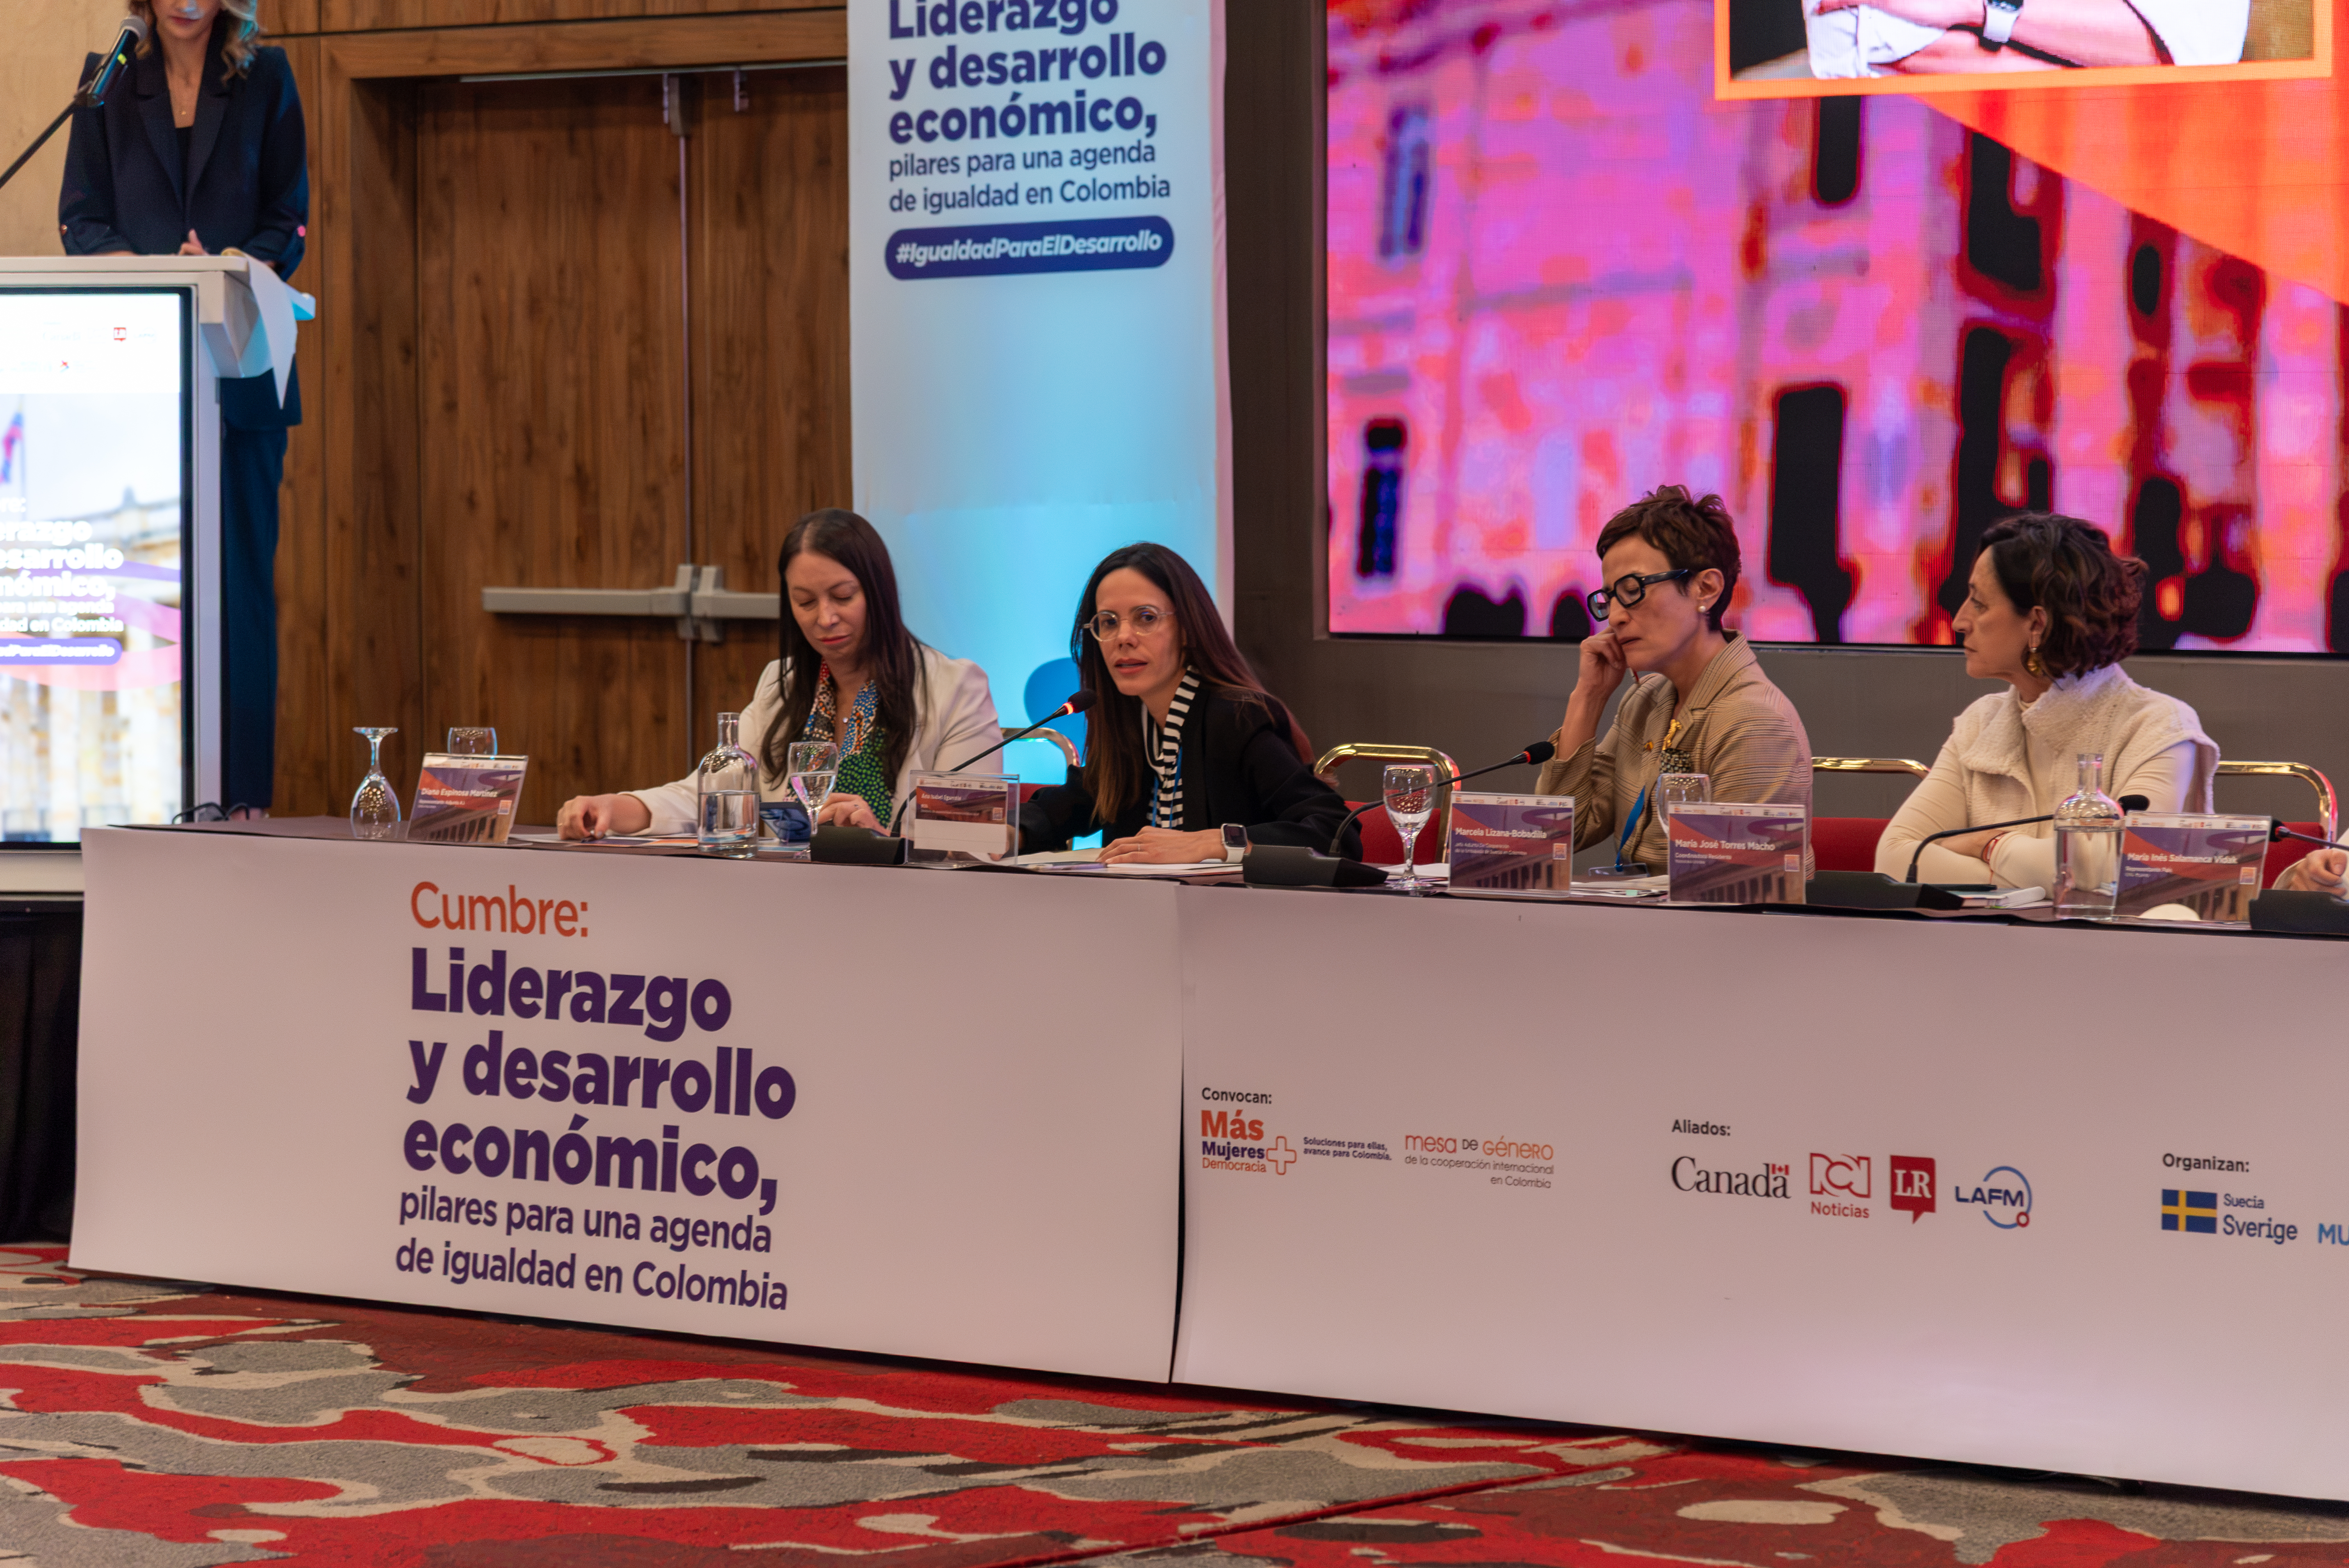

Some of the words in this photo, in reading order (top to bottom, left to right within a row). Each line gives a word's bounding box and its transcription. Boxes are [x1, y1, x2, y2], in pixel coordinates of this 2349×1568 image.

[889, 0, 1118, 39] Liderazgo
[889, 59, 916, 101] y
[929, 32, 1166, 89] desarrollo
[889, 89, 1157, 144] económico,
[889, 153, 960, 181] pilares
[967, 148, 1015, 177] para
[1023, 147, 1062, 169] una
[1070, 140, 1156, 170] agenda
[889, 188, 917, 212] de
[923, 182, 1018, 214] igualdad
[1026, 184, 1053, 205] en
[1060, 175, 1170, 203] Colombia
[895, 230, 1162, 267] #IgualdadParaElDesarrollo
[0, 521, 93, 546] razgo
[51, 617, 124, 632] Colombia
[1455, 827, 1484, 836] Marcela
[1699, 840, 1719, 849] José
[1720, 841, 1746, 850] Torres
[1747, 842, 1776, 851] Macho
[410, 881, 588, 937] Cumbre:
[411, 947, 732, 1042] Liderazgo
[406, 1040, 448, 1104] y
[463, 1030, 796, 1119] desarrollo
[1202, 1087, 1272, 1104] Convocan:
[1201, 1109, 1264, 1141] Más
[1672, 1119, 1731, 1137] Aliados:
[1202, 1141, 1265, 1161] Mujeres
[1303, 1137, 1346, 1147] Soluciones
[1303, 1147, 1330, 1156] avance
[1405, 1135, 1457, 1153] mesa
[404, 1113, 778, 1215] económico,
[1202, 1157, 1267, 1172] Democracia
[1404, 1155, 1417, 1164] de
[1419, 1155, 1428, 1165] la
[1430, 1158, 1491, 1169] cooperación
[1492, 1161, 1554, 1174] internacional
[2162, 1153, 2250, 1172] Organizan:
[1490, 1176, 1503, 1185] en
[1504, 1176, 1551, 1188] Colombia
[1672, 1156, 1792, 1199] Canada
[1893, 1169, 1932, 1199] LR
[1810, 1201, 1870, 1219] Noticias
[2223, 1193, 2265, 1209] Suecia
[399, 1185, 498, 1227] pilares
[506, 1199, 574, 1235] para
[584, 1208, 641, 1240] una
[650, 1215, 772, 1253] agenda
[2222, 1214, 2298, 1245] Sverige
[395, 1237, 434, 1274] de
[442, 1241, 576, 1288] igualdad
[585, 1263, 623, 1294] en
[633, 1261, 788, 1310] Colombia
